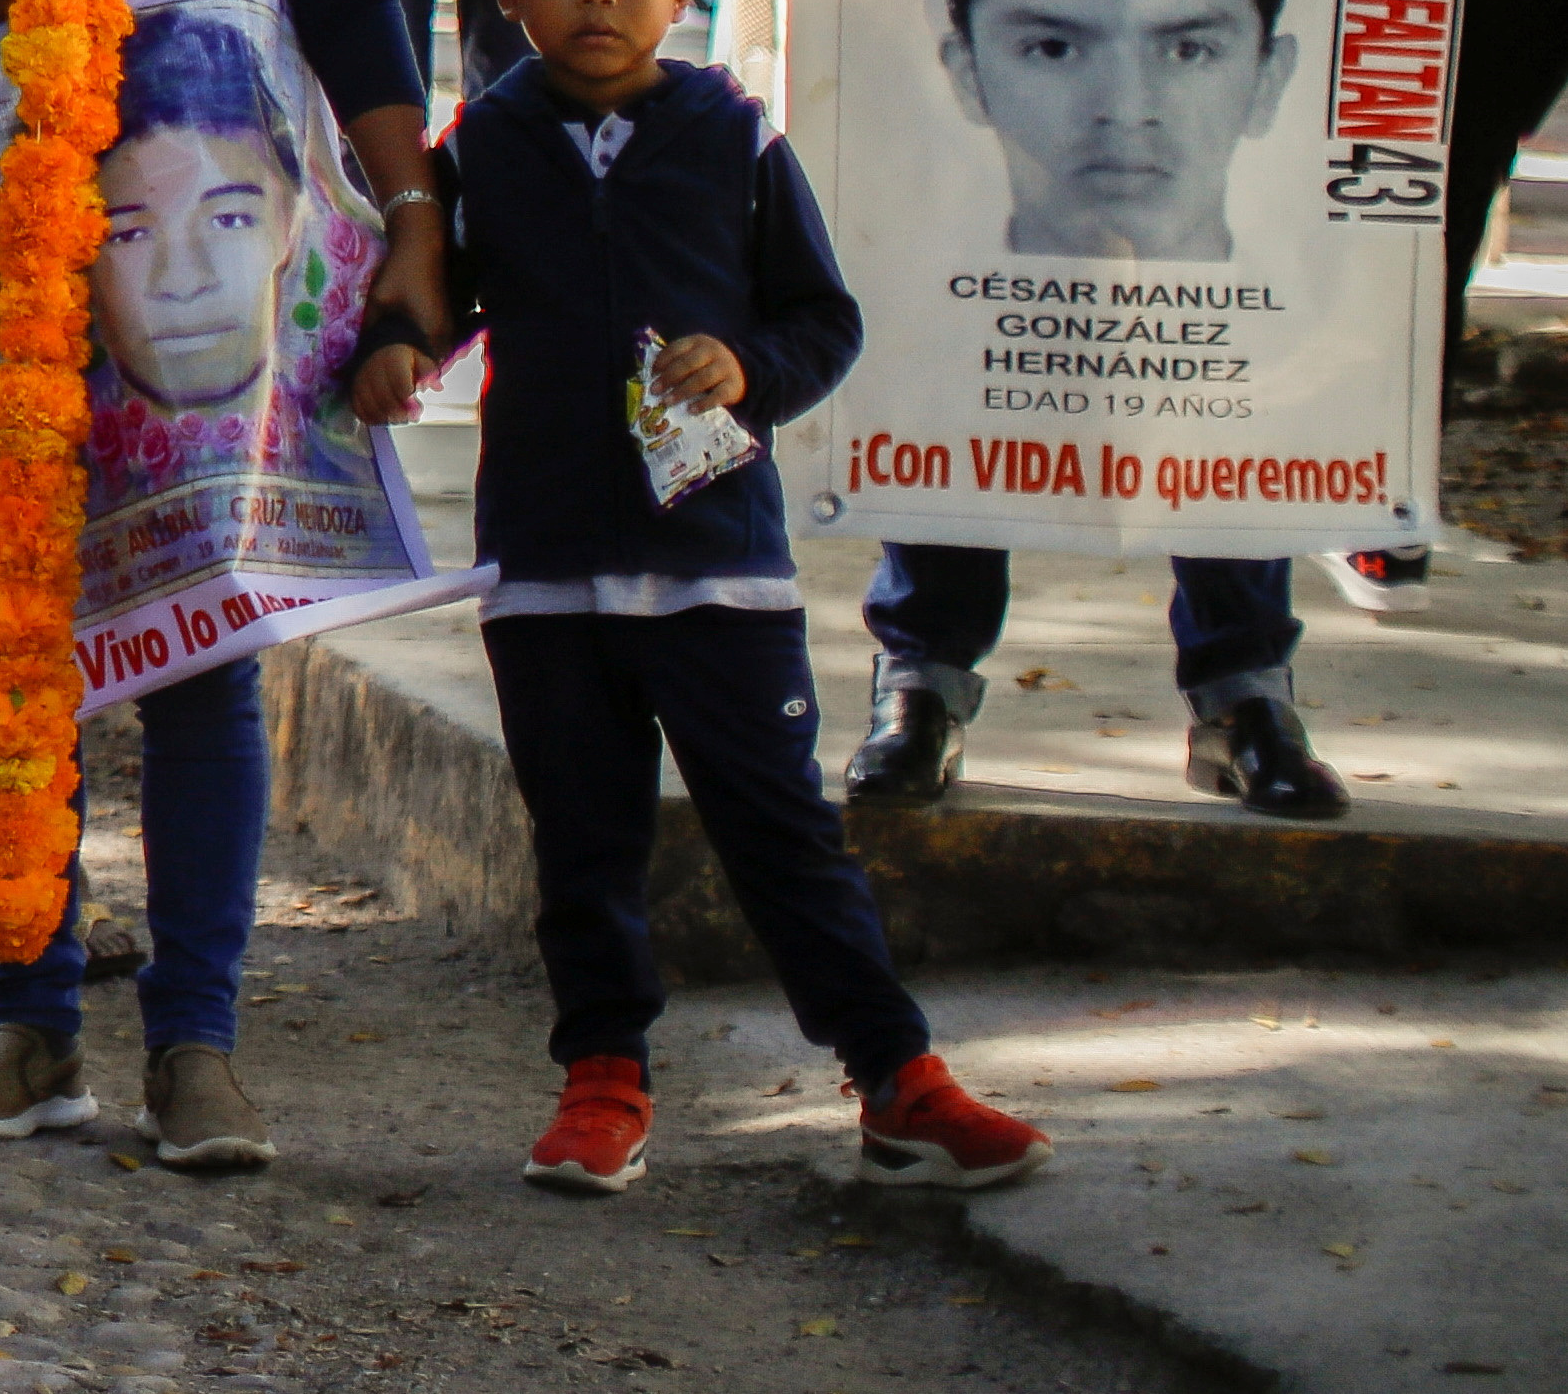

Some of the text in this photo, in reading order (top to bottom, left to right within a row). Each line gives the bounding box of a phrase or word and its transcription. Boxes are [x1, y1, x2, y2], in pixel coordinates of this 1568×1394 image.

[949, 272, 1284, 311] CÉSAR MANUEL
[997, 312, 1230, 346] GONZÁLEZ
[985, 349, 1249, 382] HERNÁNDEZ
[985, 388, 1251, 419] EDAD 19 AÑOS
[849, 433, 1387, 510] ¡Con VIDA lo queremos!
[229, 497, 287, 527] CRUZ
[172, 604, 218, 657] lo
